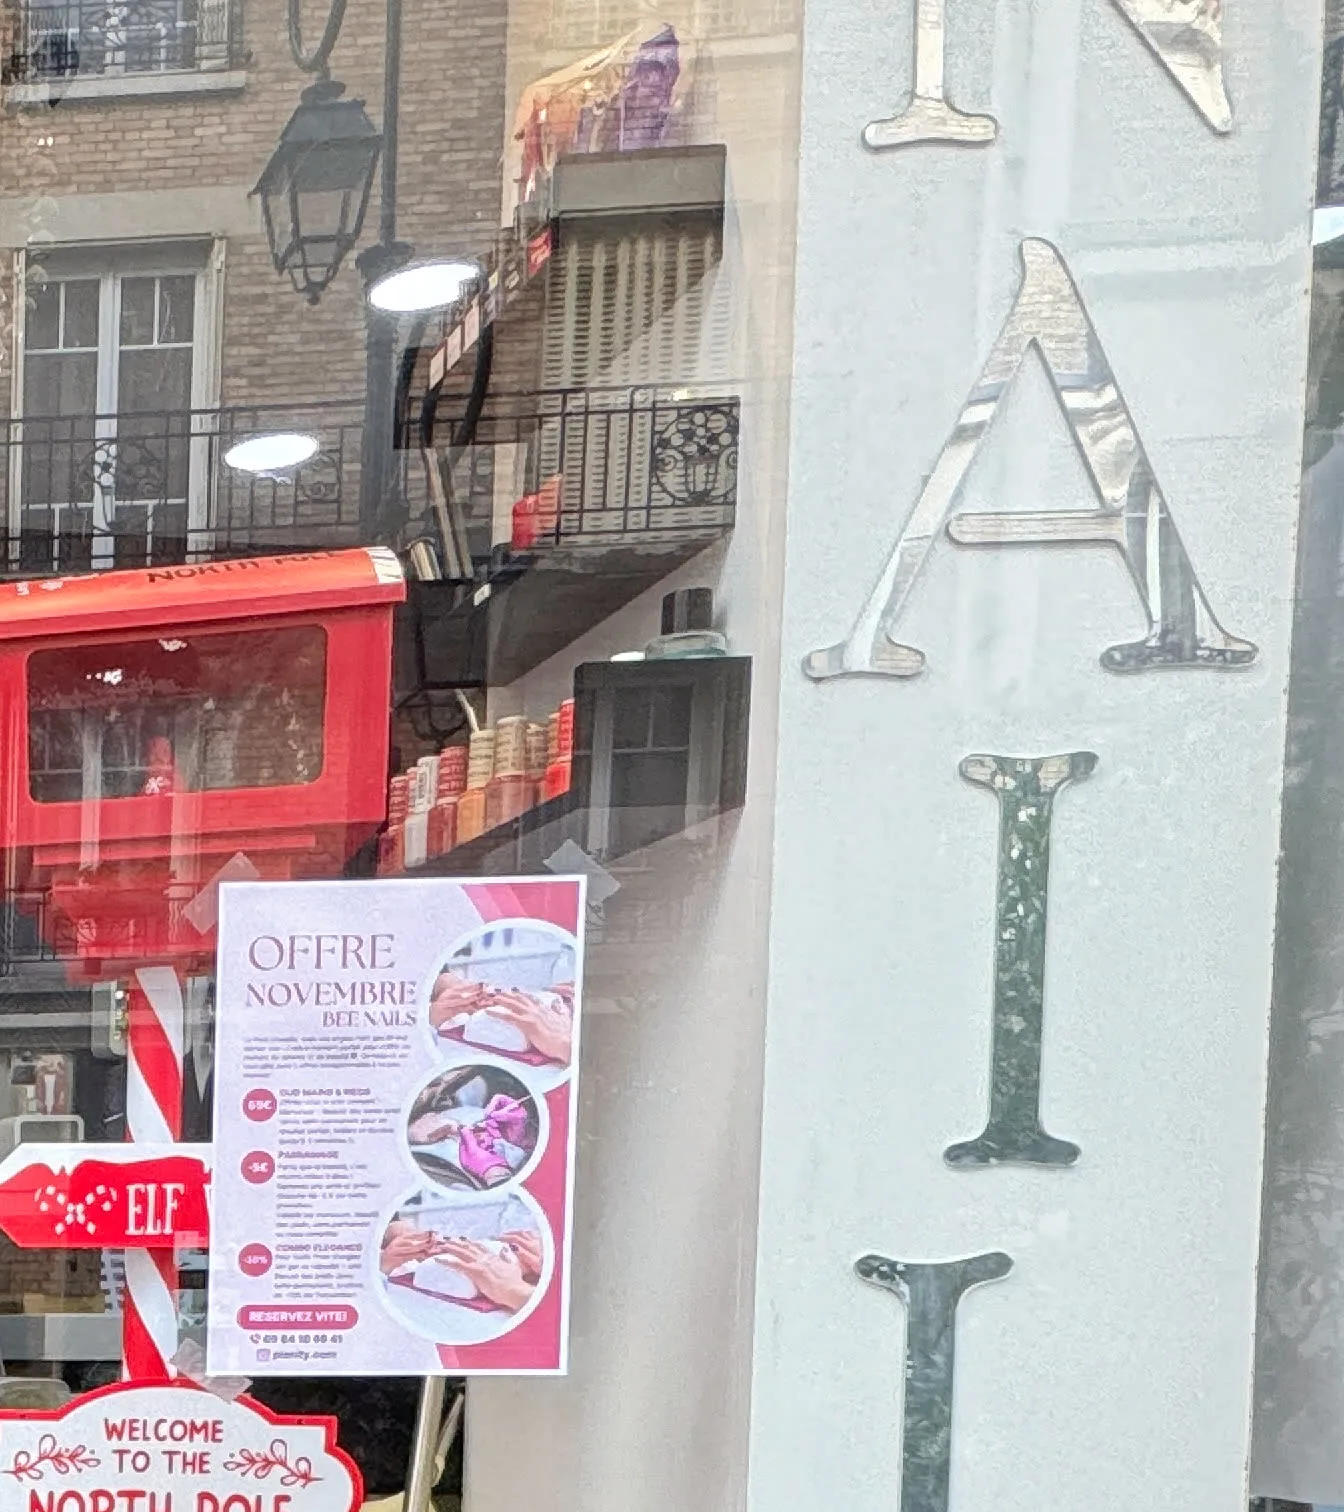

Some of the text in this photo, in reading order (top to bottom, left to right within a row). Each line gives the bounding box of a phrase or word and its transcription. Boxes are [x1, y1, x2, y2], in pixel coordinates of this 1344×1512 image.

[249, 934, 395, 971] OFFRE
[245, 981, 417, 1007] NOVEMBRE
[322, 1010, 417, 1027] BEE NAILS
[124, 1183, 185, 1236] ELF
[104, 1418, 224, 1444] WELCOME
[113, 1449, 211, 1475] TO THE
